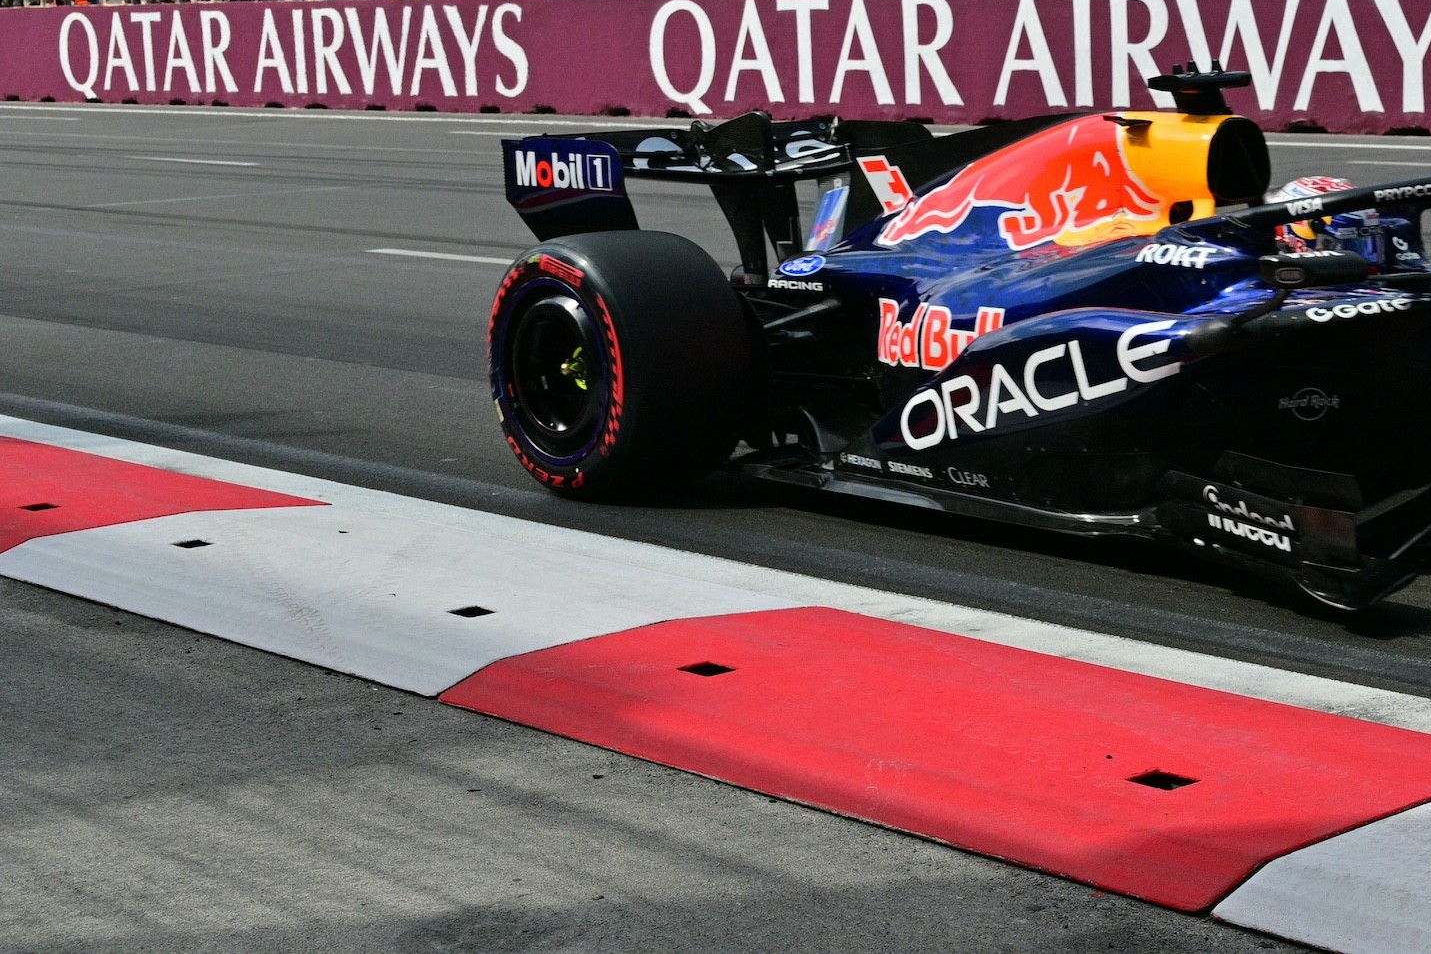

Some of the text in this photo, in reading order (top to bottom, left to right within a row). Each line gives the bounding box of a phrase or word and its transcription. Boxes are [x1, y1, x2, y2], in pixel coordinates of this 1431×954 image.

[58, 2, 530, 101] QATAR AIRWAYS
[514, 150, 606, 190] Mobil 1
[1285, 197, 1324, 217] VISA
[1135, 243, 1217, 269] ROKT
[768, 279, 824, 293] RACING
[1332, 292, 1415, 320] Gate
[877, 296, 1006, 372] Red Bull
[900, 319, 1182, 451] ORACLE
[887, 460, 933, 479] SIEMENS
